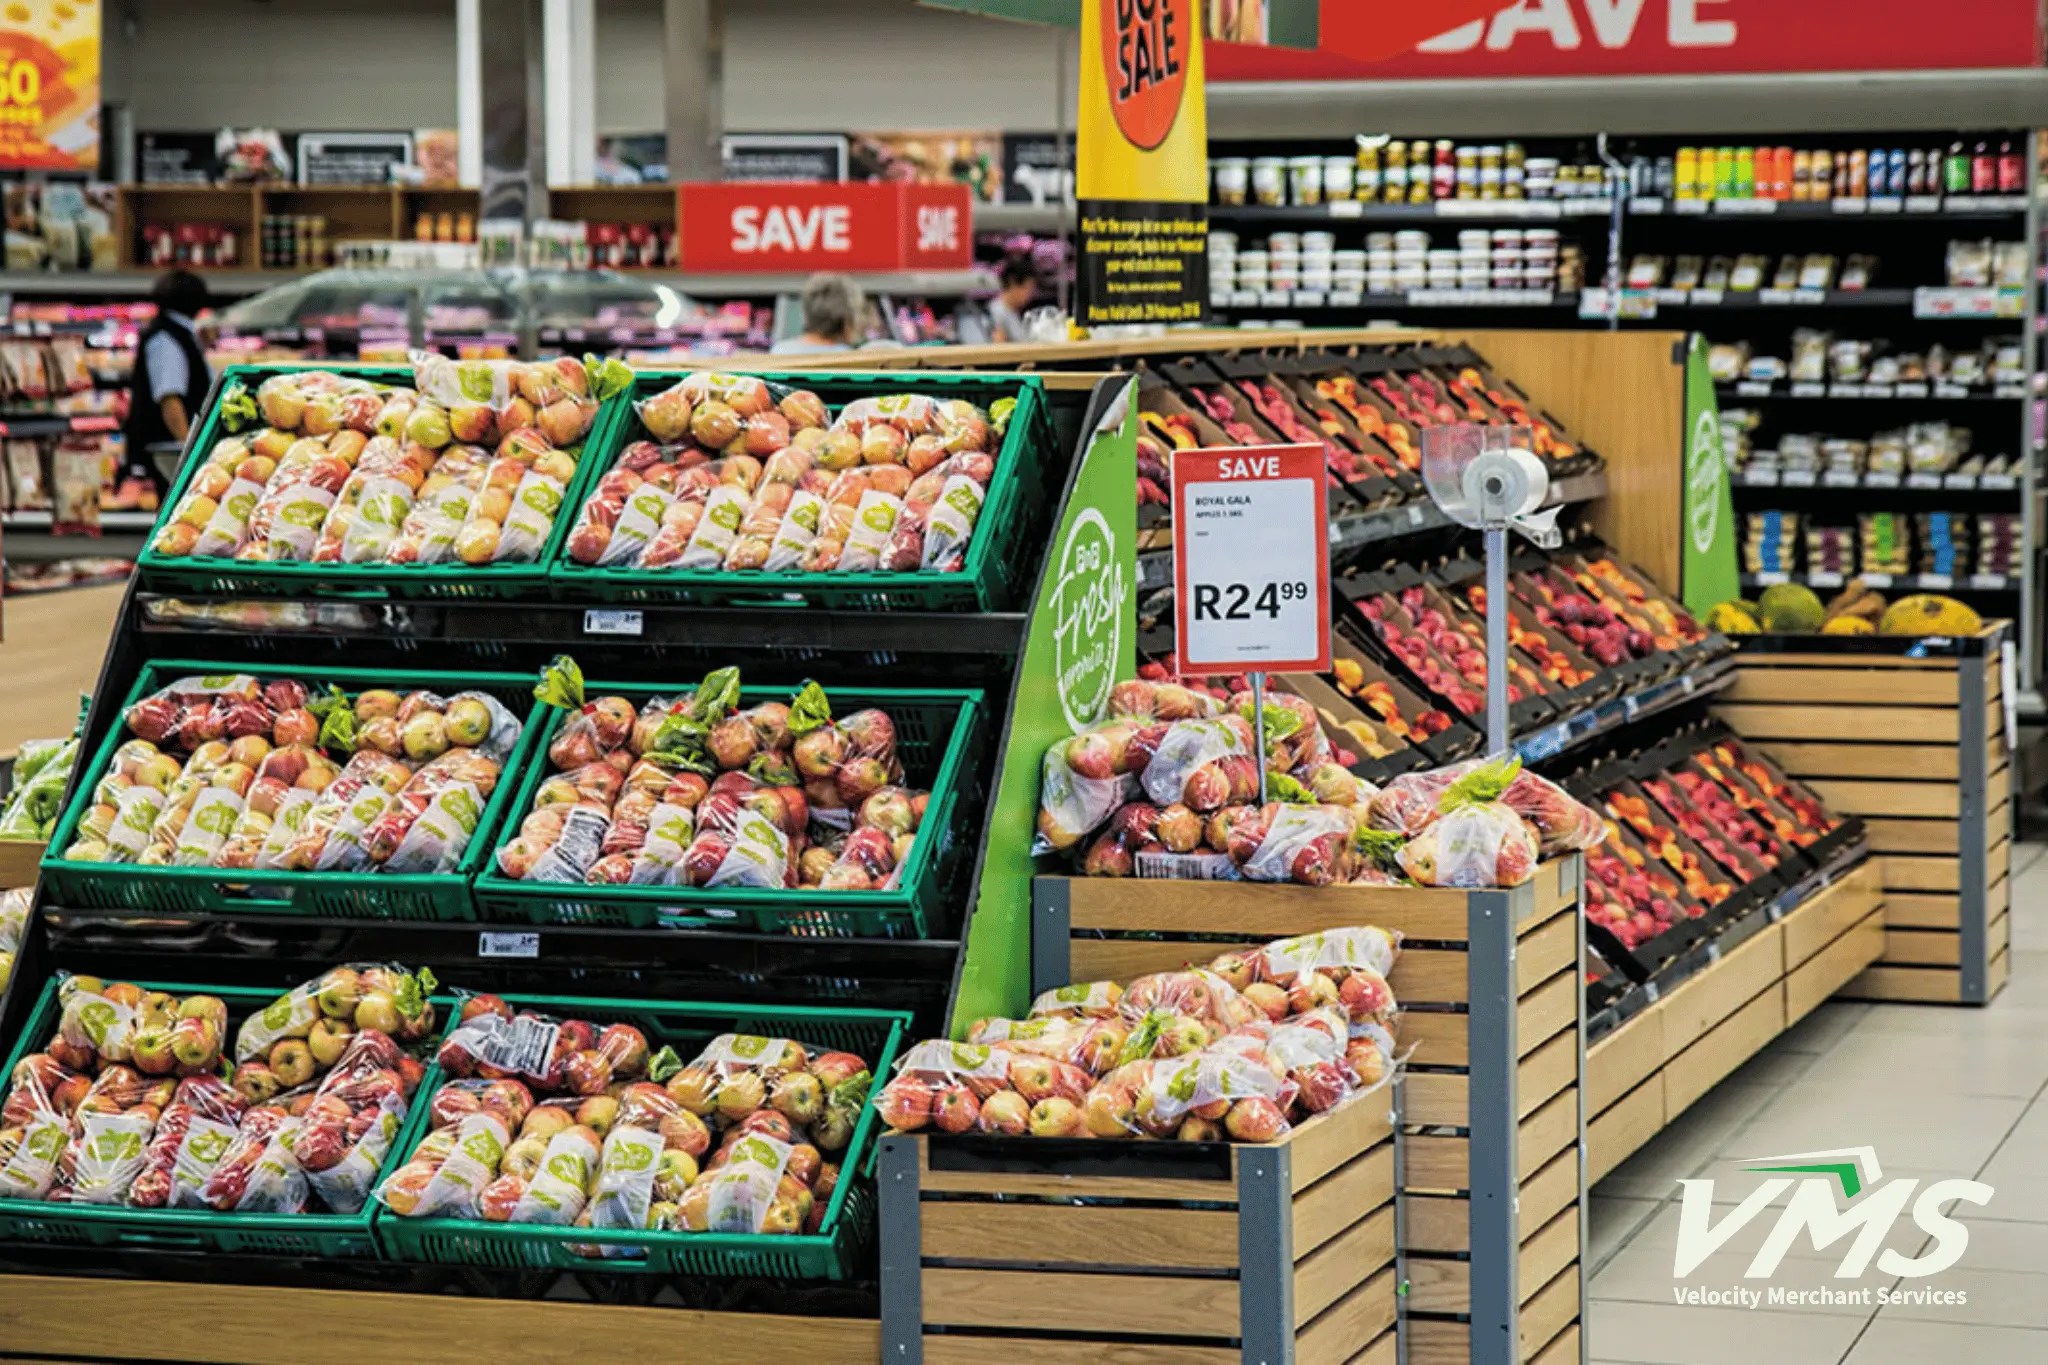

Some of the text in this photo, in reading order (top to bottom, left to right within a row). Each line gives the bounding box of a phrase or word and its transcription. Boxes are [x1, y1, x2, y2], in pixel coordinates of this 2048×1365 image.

[1118, 8, 1179, 101] SALE
[731, 206, 851, 252] SAVE
[1218, 457, 1280, 478] SAVE
[1195, 495, 1252, 506] ROYAL GALA
